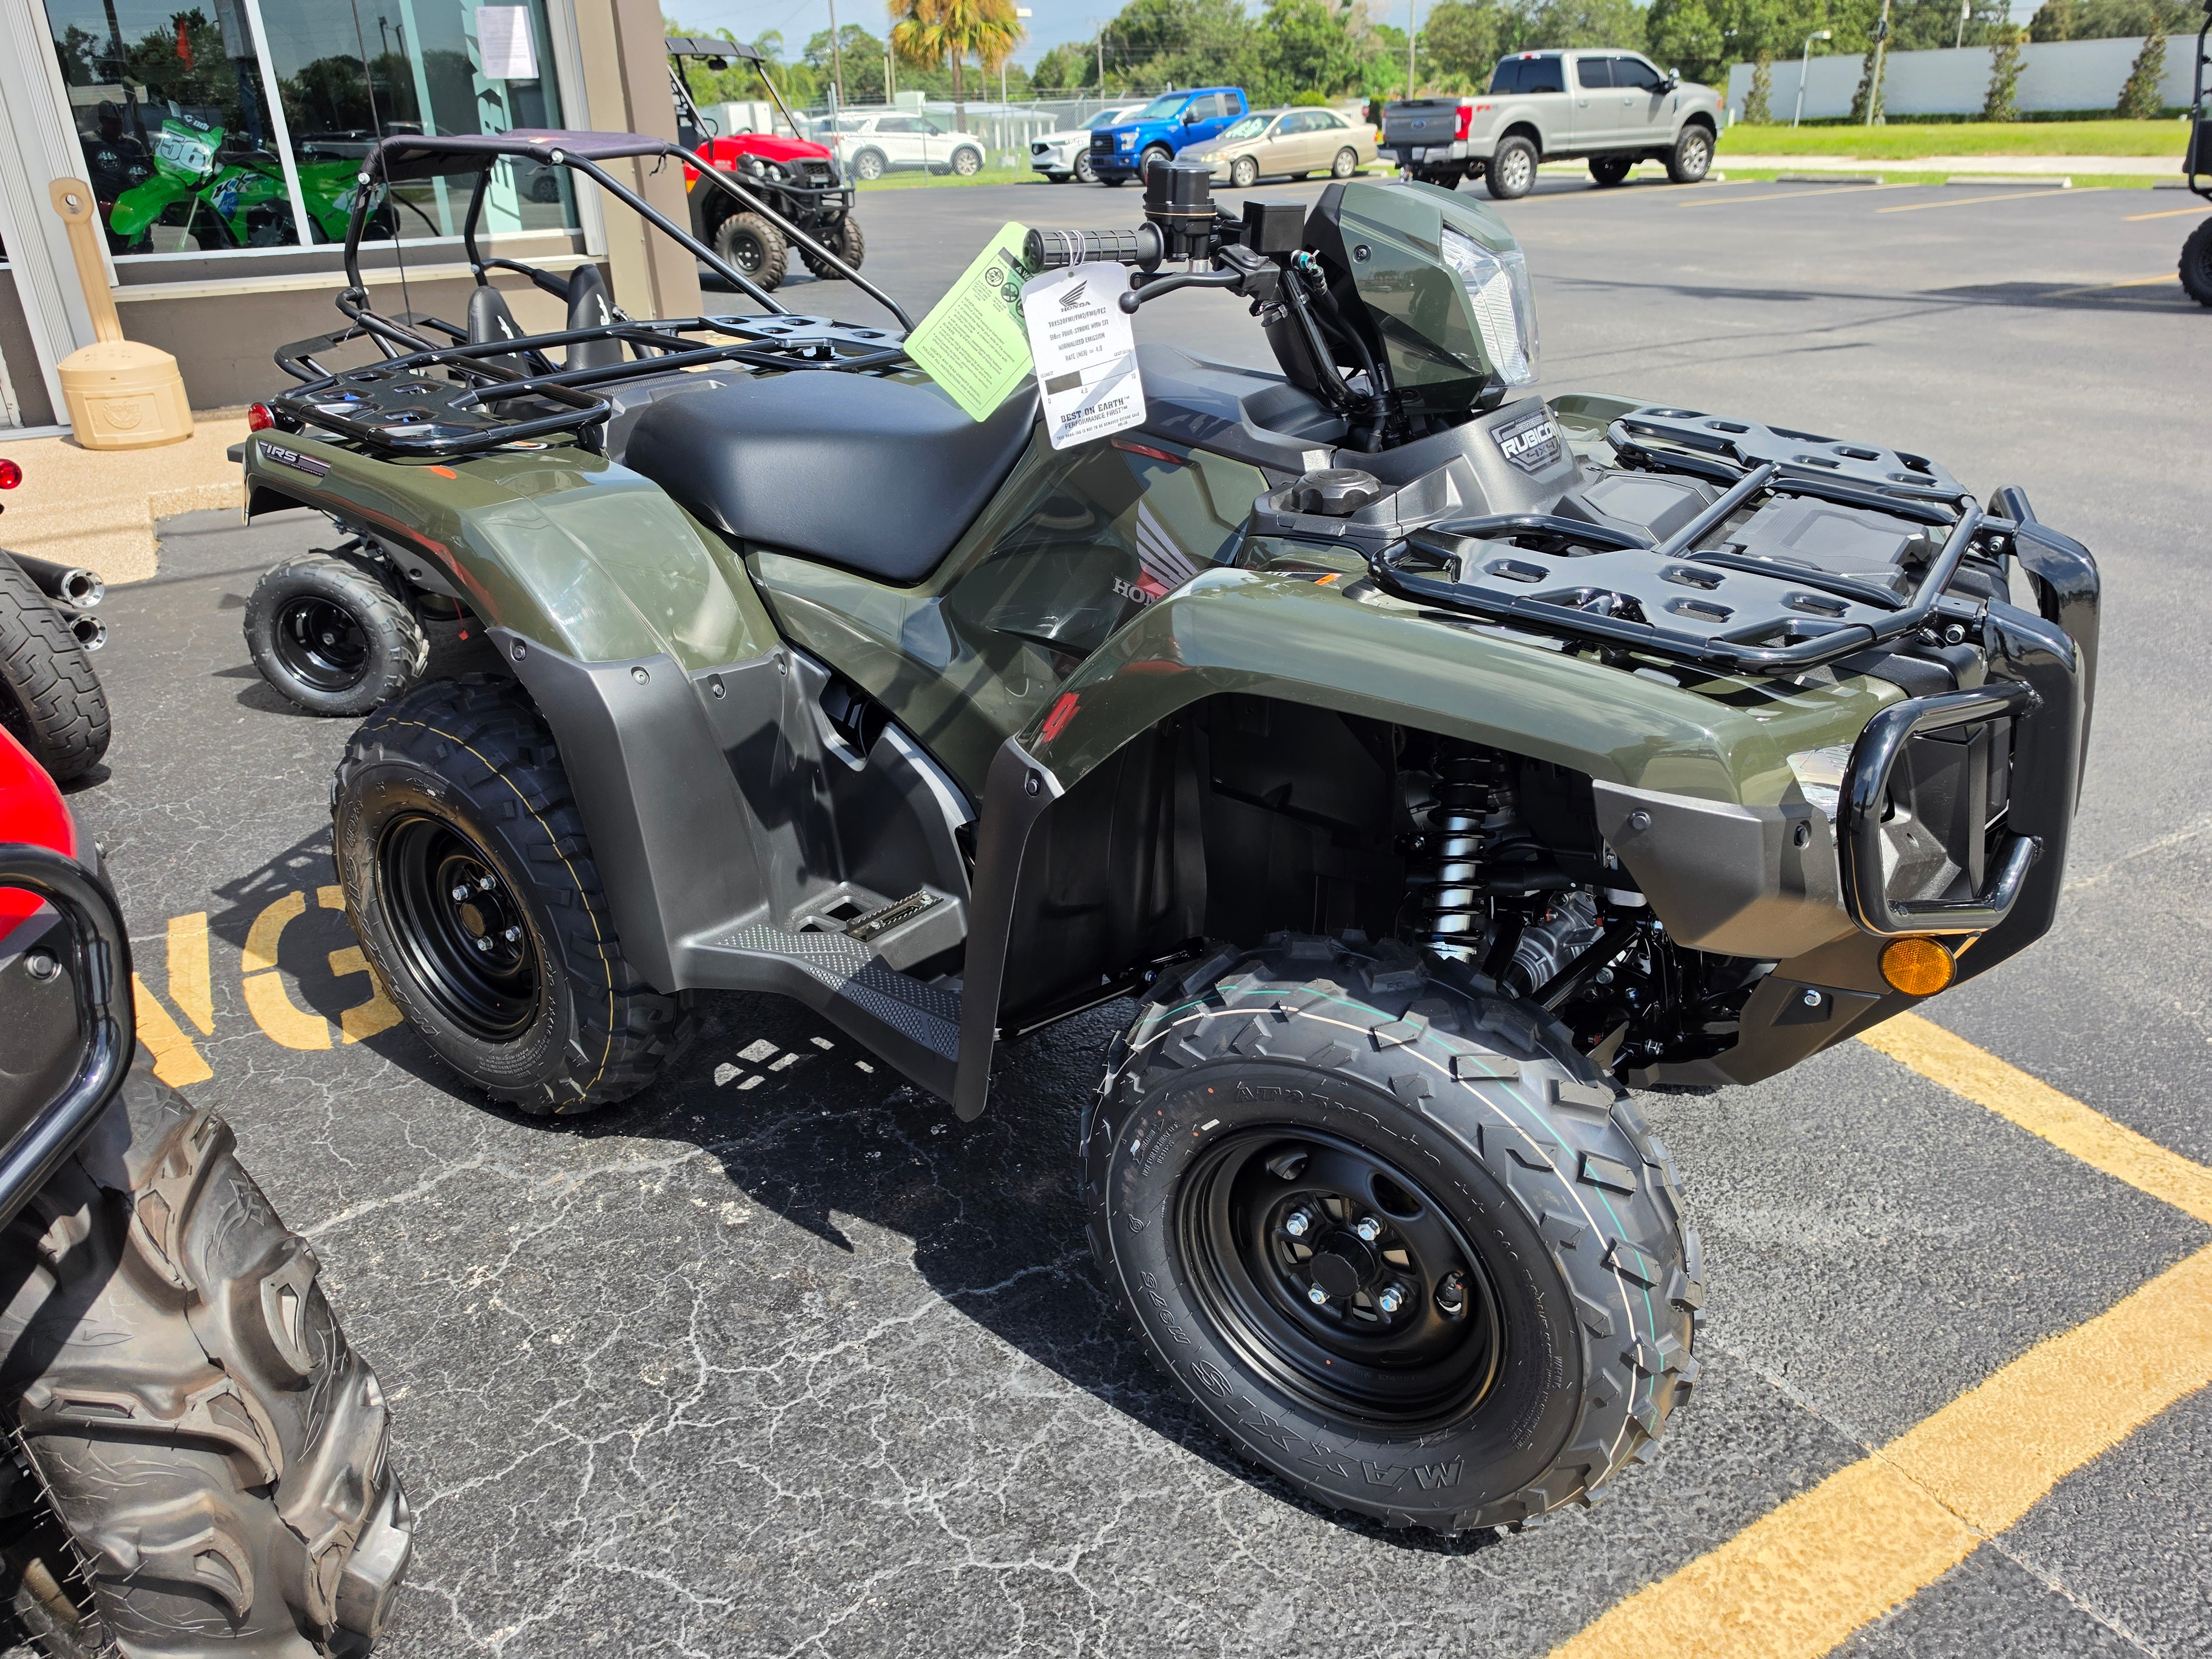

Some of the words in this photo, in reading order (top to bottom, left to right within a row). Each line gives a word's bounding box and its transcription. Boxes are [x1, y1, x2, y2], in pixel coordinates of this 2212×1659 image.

[160, 131, 206, 170] 56
[963, 296, 974, 307] NEVER
[1060, 301, 1091, 312] HONDA
[1061, 324, 1091, 337] FOUR-STROKE
[1084, 332, 1105, 342] EMISSION
[921, 346, 935, 359] FOLLOW
[930, 346, 942, 359] LOCATE
[947, 364, 957, 373] READ
[1065, 353, 1076, 361] RATE
[1060, 410, 1082, 422] BEST
[1084, 406, 1095, 415] ON
[1064, 412, 1106, 429] PERFORMANCE
[1500, 421, 1556, 459] RUBICON
[267, 446, 297, 461] IRS
[1112, 577, 1160, 606] HON
[1146, 1151, 1156, 1164] FOR
[1142, 1164, 1151, 1176] NOT
[1141, 1270, 1191, 1344] M975
[1191, 1359, 1464, 1490] MAXXIS
